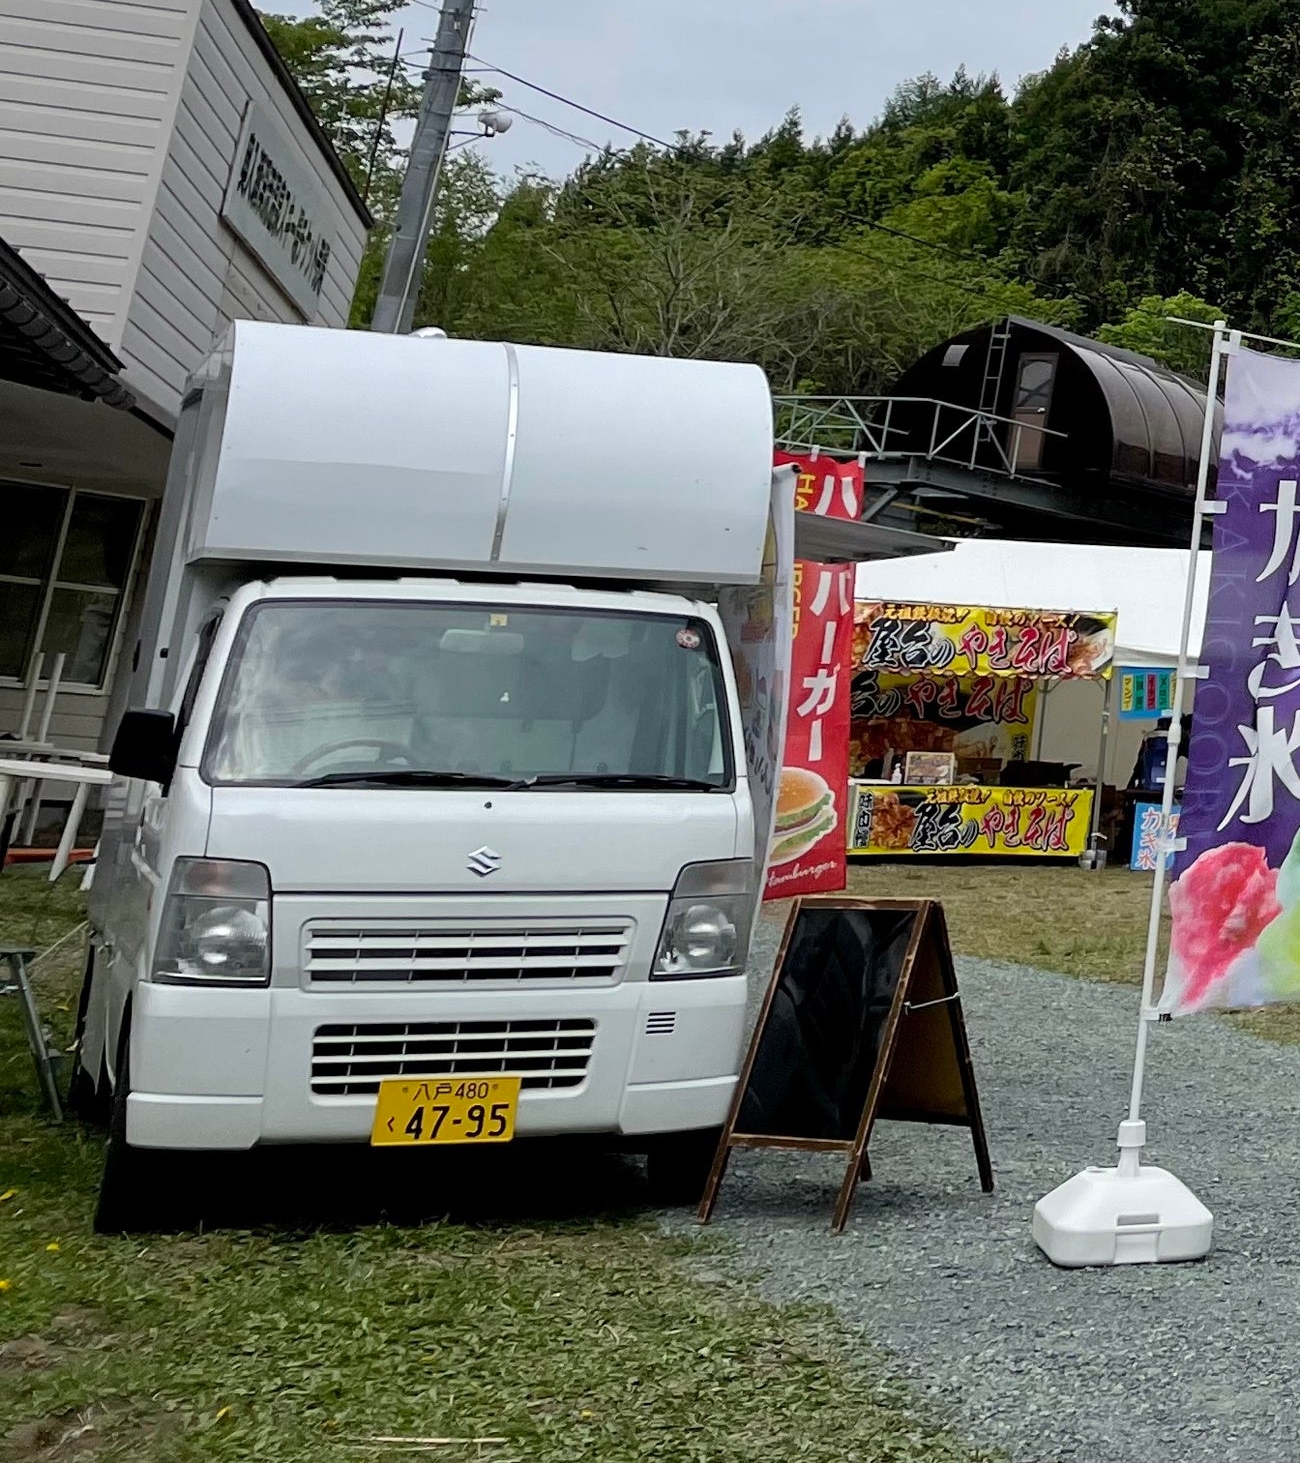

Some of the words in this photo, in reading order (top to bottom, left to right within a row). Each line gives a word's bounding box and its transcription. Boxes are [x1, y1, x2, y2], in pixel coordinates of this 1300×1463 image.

[862, 617, 1077, 674] 屋台のやきそば
[909, 802, 1075, 852] 屋台のやきそば
[404, 1103, 510, 1140] 47-95
